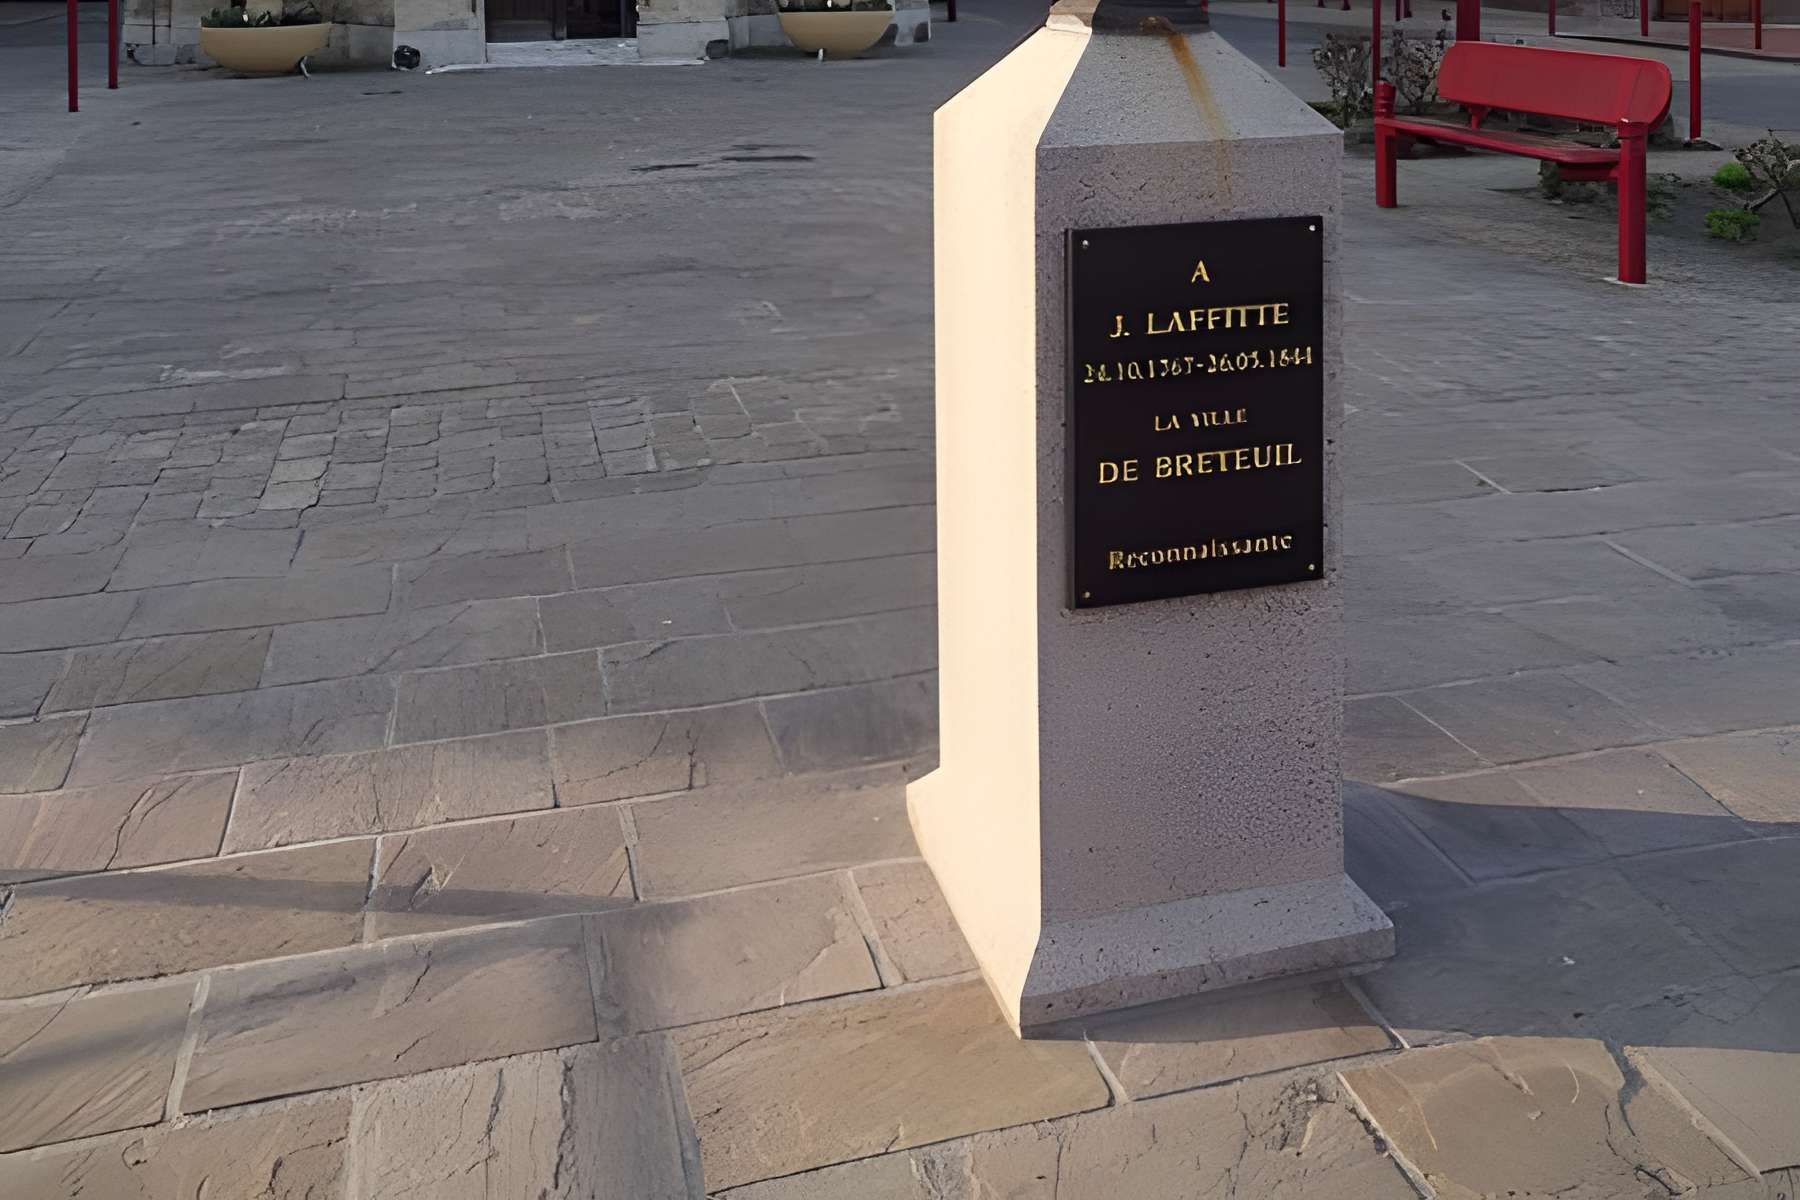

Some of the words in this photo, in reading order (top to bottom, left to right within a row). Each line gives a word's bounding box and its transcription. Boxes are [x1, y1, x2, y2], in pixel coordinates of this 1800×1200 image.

[1191, 260, 1211, 283] A
[1109, 315, 1131, 338] J.
[1145, 303, 1290, 335] LAFFITTE
[1154, 414, 1181, 432] LA
[1191, 408, 1248, 428] VILLE
[1098, 459, 1139, 484] DE
[1155, 443, 1303, 479] BRETEUIL
